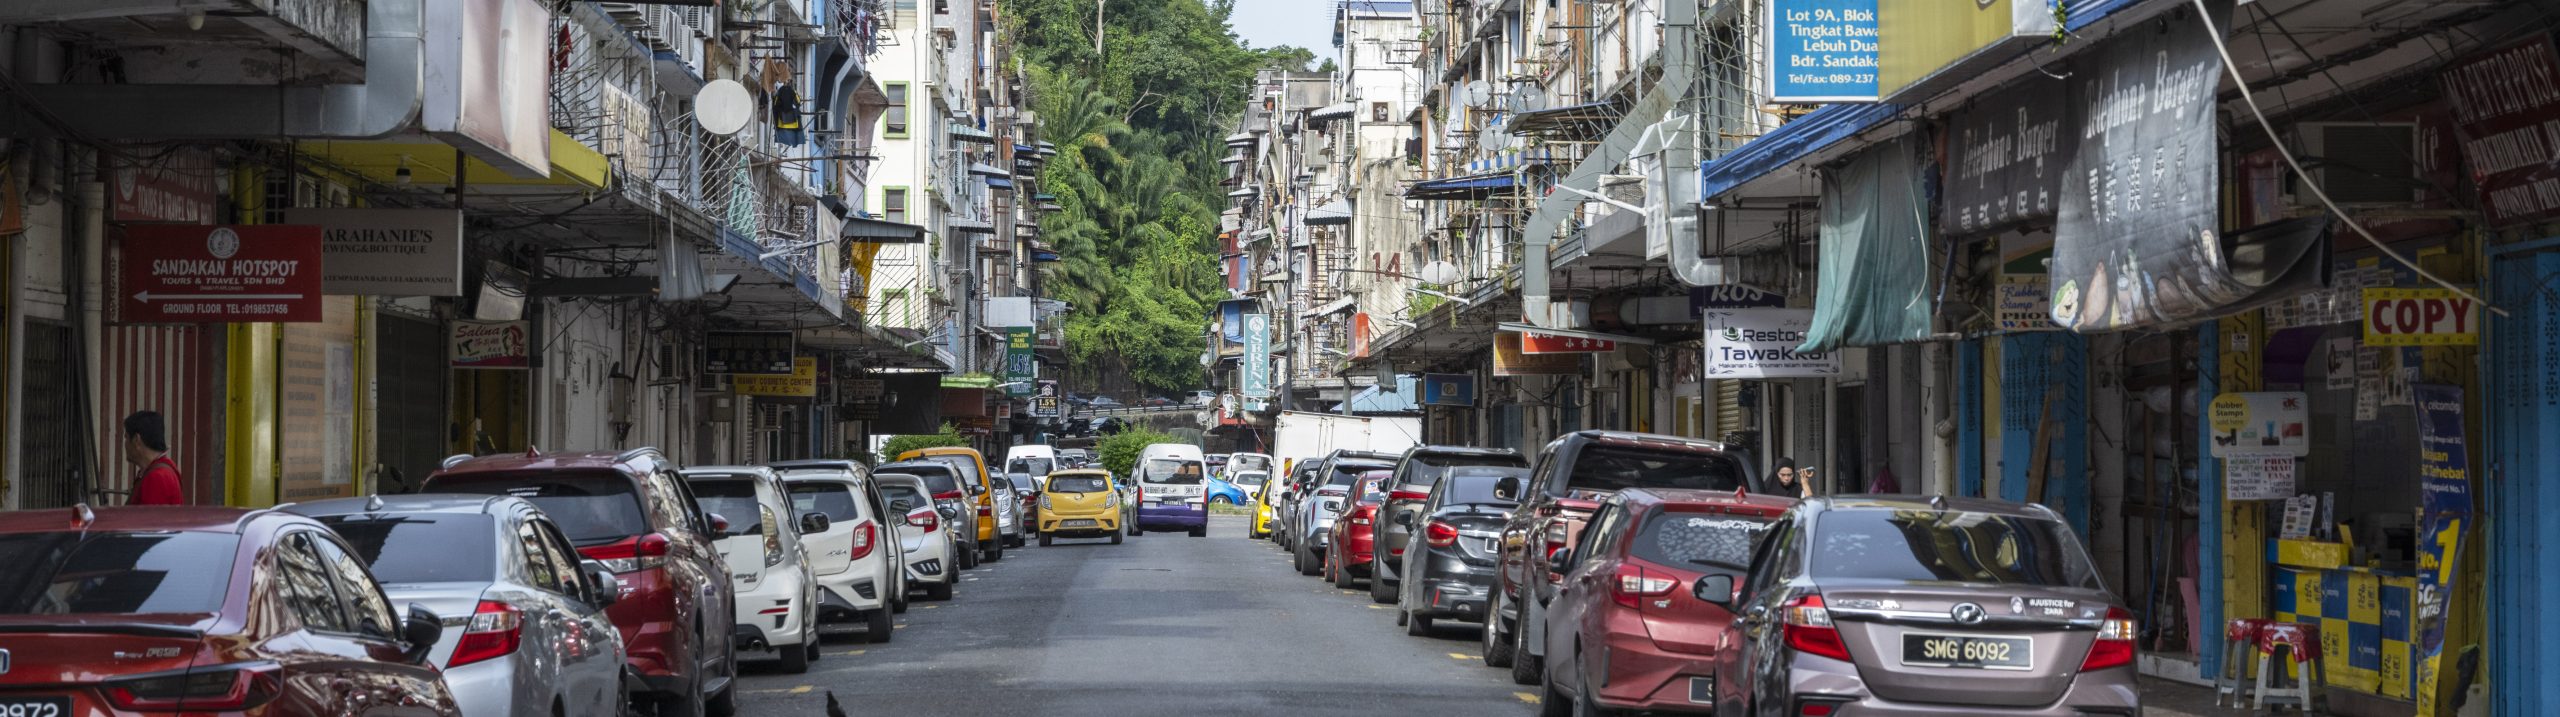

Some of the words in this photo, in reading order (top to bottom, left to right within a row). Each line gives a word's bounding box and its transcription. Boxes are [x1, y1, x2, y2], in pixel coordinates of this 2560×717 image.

[1787, 9, 1810, 21] Lot
[1815, 9, 1840, 23] 9A,
[1844, 9, 1874, 21] Blok
[1789, 24, 1838, 39] Tingkat
[1804, 40, 1846, 51] Lebuh
[1851, 40, 1878, 51] Dua
[1791, 55, 1823, 67] Bdr.
[1789, 74, 1828, 84] Tel/Fax:
[1830, 74, 1874, 83] 089-237
[2084, 68, 2146, 147] Telephone
[2153, 50, 2206, 132] Burger
[1962, 123, 2012, 189] Telephone
[2017, 107, 2058, 178] Burger
[323, 229, 433, 243] ARAHANIE'S
[152, 260, 225, 276] SANDAKAN
[232, 260, 298, 276] HOTSPOT
[1372, 252, 1401, 282] 14
[162, 304, 194, 314] GROUND
[197, 304, 221, 314] FLOOR
[226, 304, 240, 314] TEL
[2372, 299, 2471, 334] COPY
[455, 325, 500, 338] Salina
[1743, 328, 1806, 342] Restor
[1010, 354, 1030, 374] 1.5%
[1249, 333, 1264, 389] SERENA
[791, 378, 812, 386] CENTRE
[1039, 398, 1056, 406] 1.5%
[2215, 410, 2244, 418] Stamps
[2029, 599, 2060, 608] #JUSTICE
[2062, 600, 2074, 608] for
[1923, 640, 1957, 660] SMG
[1963, 643, 2010, 662] 6092
